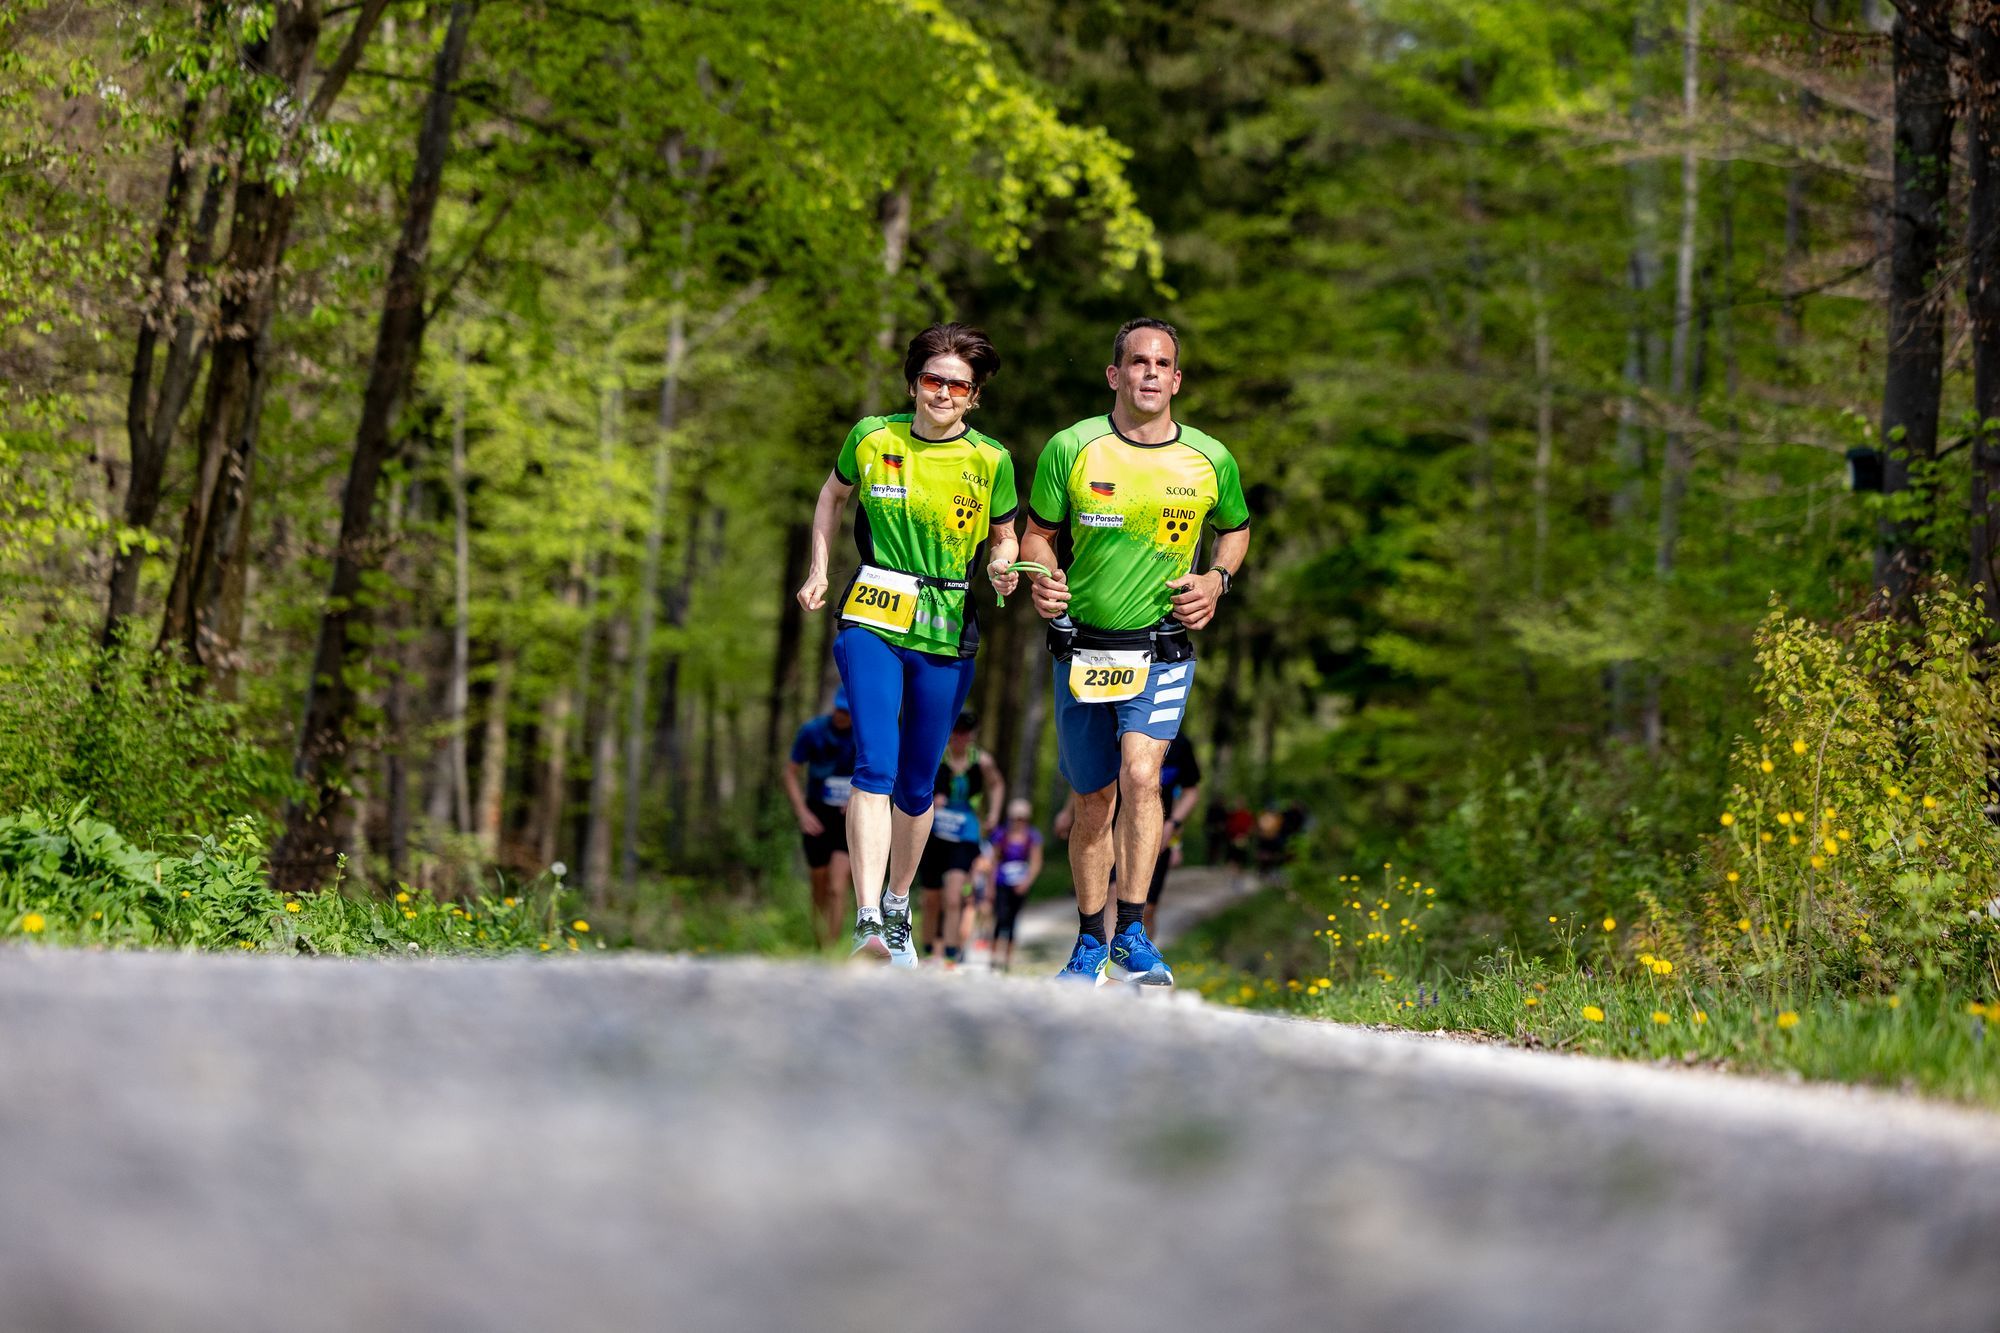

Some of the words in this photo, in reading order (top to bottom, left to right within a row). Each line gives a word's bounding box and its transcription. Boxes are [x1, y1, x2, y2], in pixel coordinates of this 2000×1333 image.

[962, 471, 989, 488] S.COOL
[1166, 486, 1198, 497] S.COOL
[953, 495, 984, 513] GUIDE
[1079, 512, 1095, 523] Ferry
[1095, 514, 1124, 523] Porsche
[1162, 507, 1196, 520] BLIND
[855, 585, 902, 612] 2301
[1084, 669, 1135, 686] 2300
